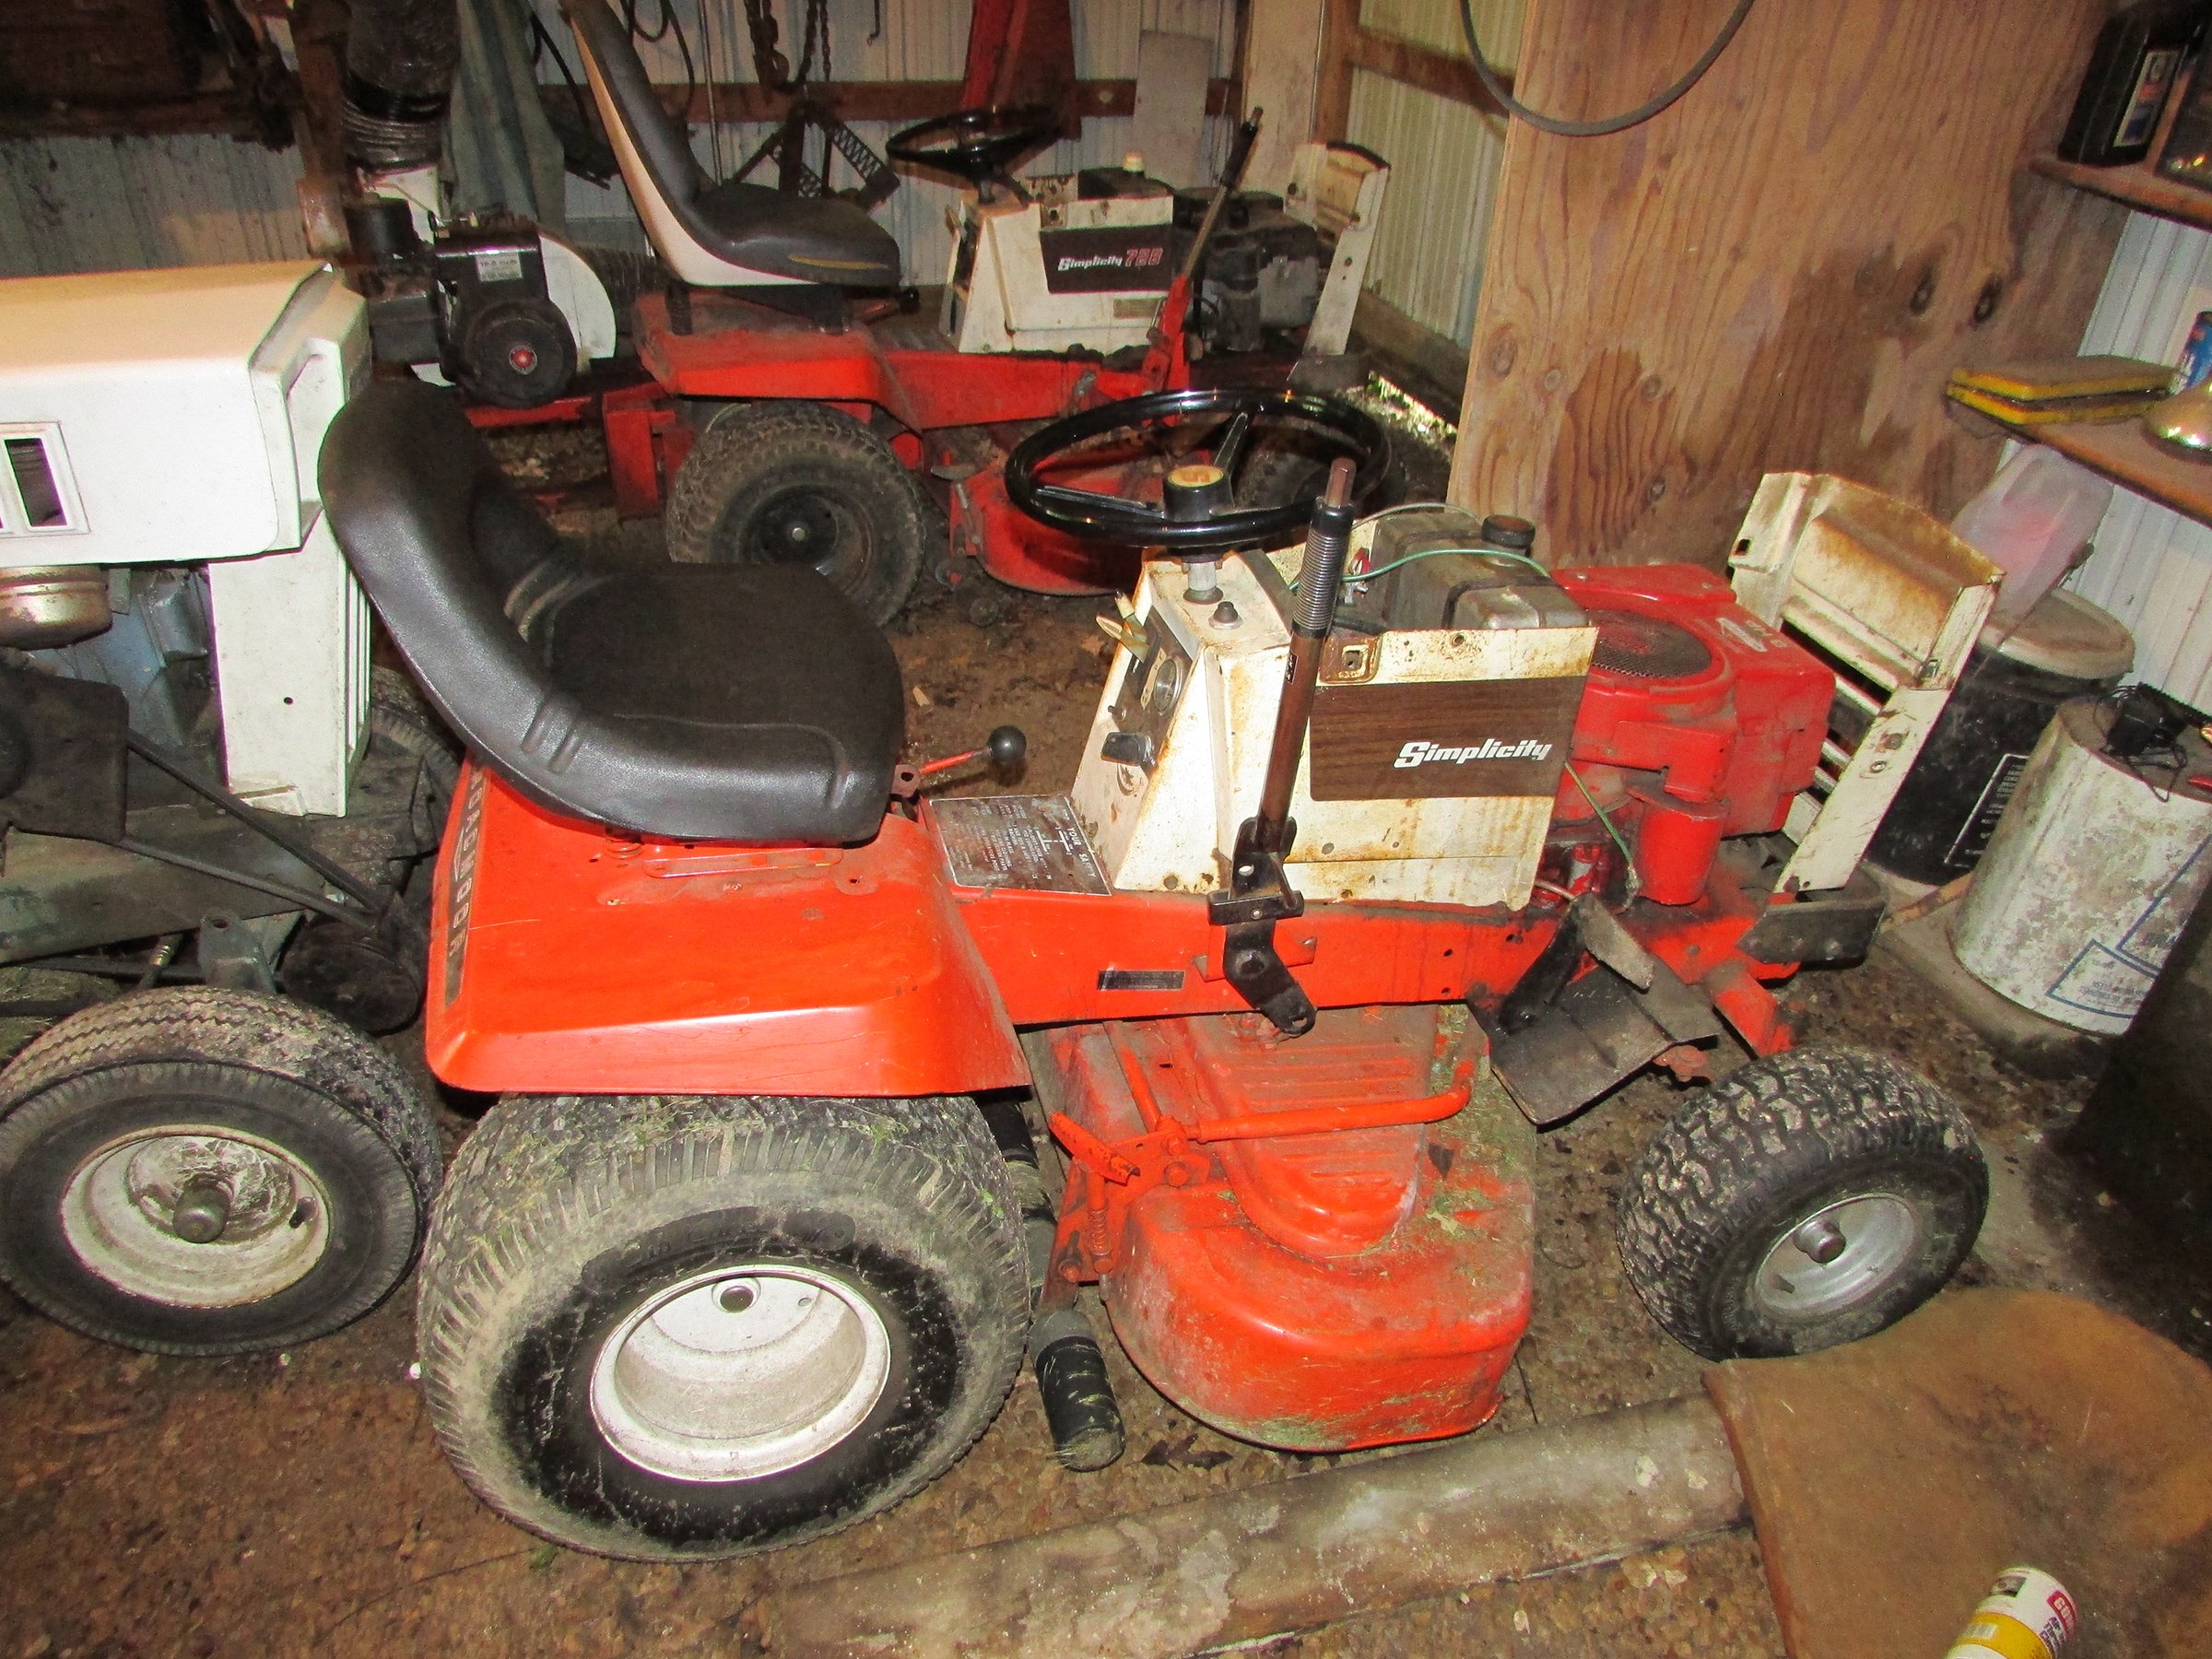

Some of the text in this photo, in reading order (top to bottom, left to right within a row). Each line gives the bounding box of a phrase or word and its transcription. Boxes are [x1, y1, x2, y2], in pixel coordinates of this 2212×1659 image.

[1057, 255, 1123, 272] Simplicity
[1394, 738, 1552, 769] Simplicity
[1065, 827, 1082, 845] YOUR
